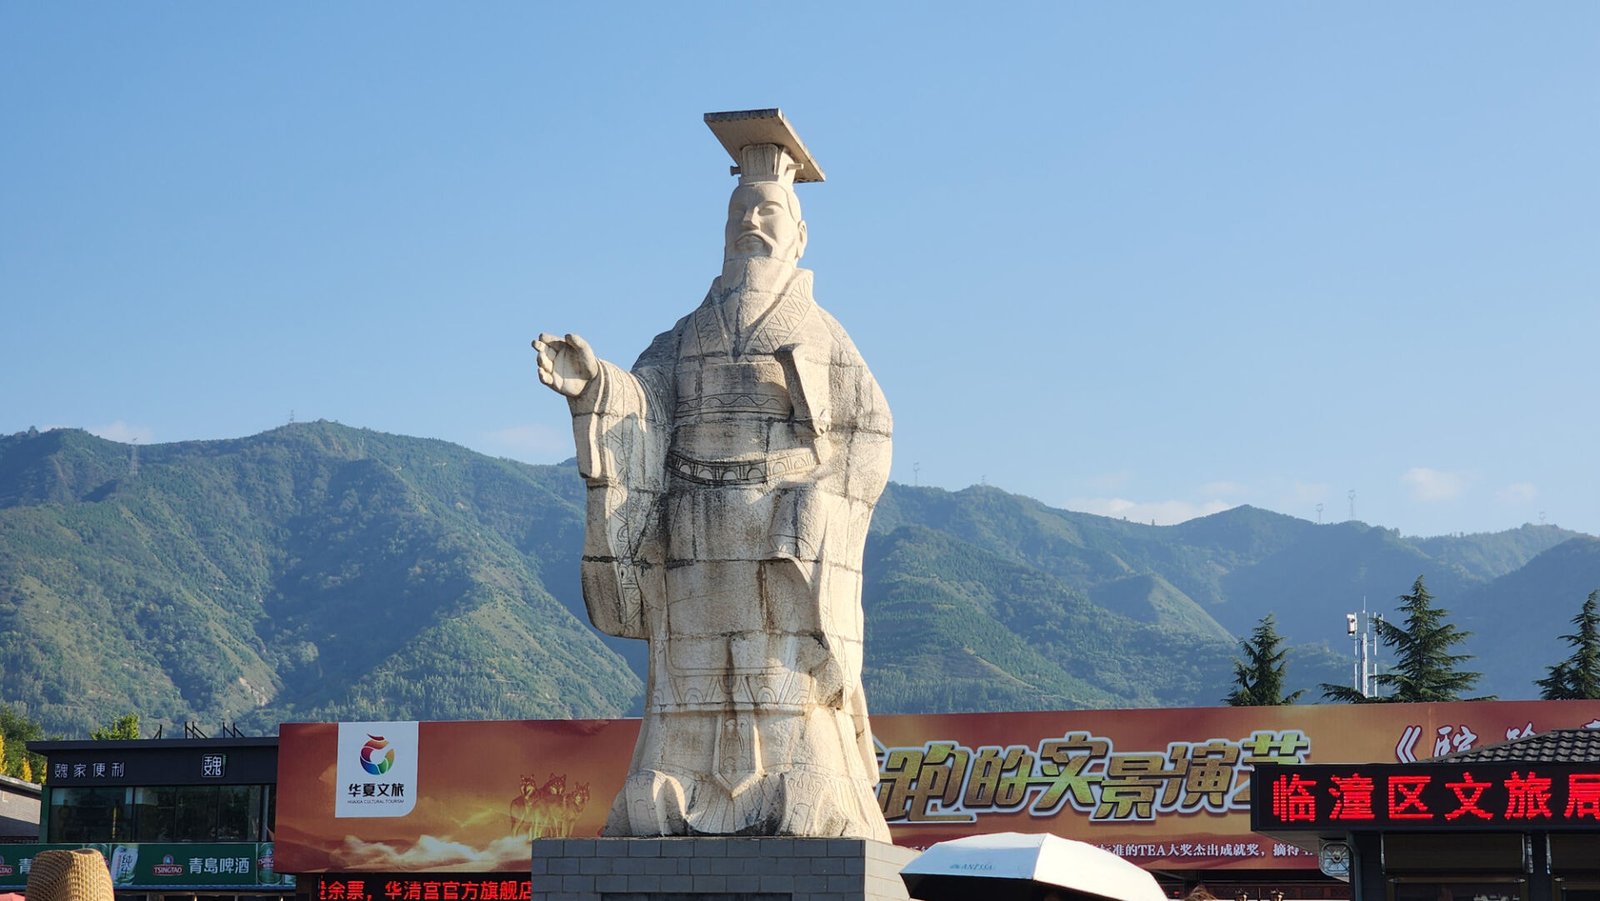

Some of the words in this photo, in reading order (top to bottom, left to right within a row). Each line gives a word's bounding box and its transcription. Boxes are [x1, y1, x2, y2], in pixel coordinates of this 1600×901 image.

[54, 761, 125, 778] 魏家便利
[204, 756, 222, 776] 魏
[872, 731, 1310, 821] 跑的实景演艺
[348, 783, 405, 798] 华夏文旅
[1272, 770, 1600, 823] 临潼区文旅局
